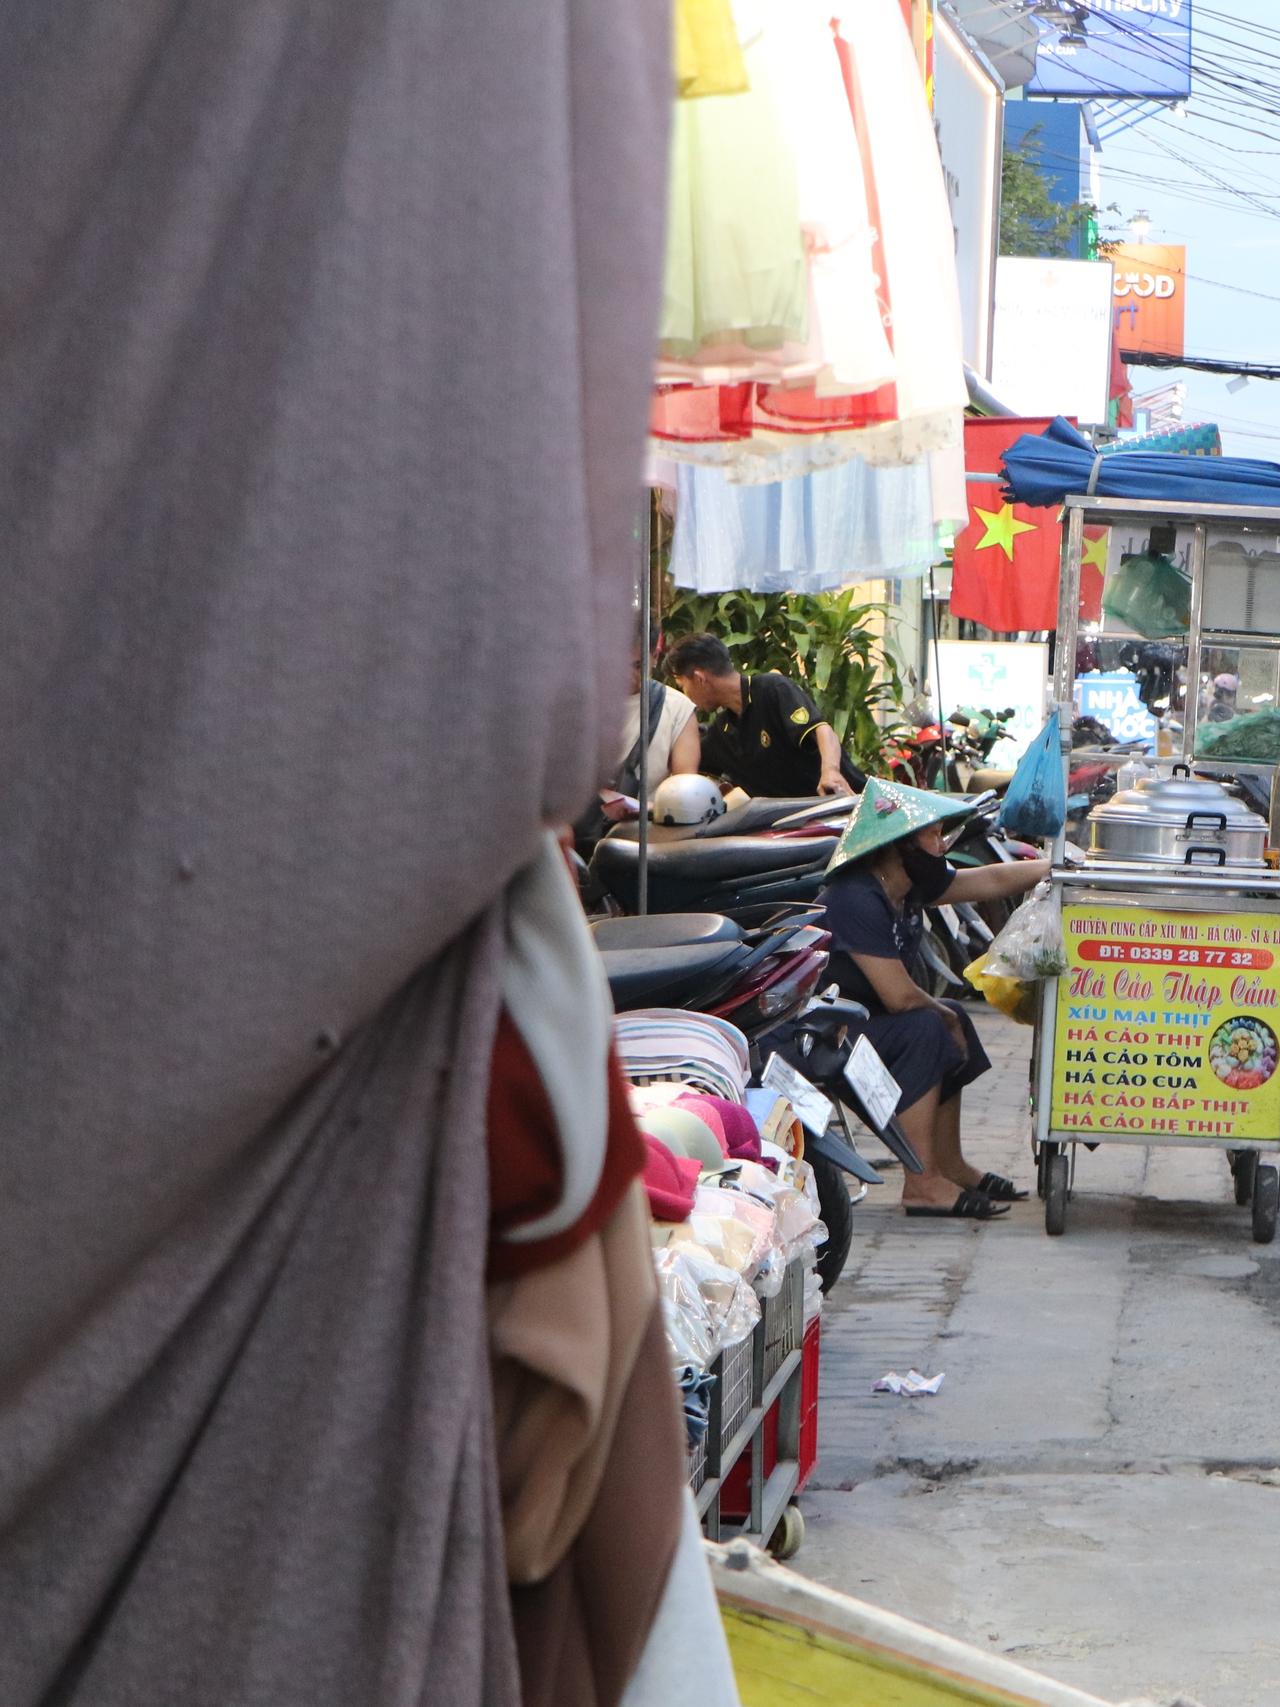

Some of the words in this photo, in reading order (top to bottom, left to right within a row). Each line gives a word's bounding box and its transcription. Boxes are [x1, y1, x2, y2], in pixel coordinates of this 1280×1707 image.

[1113, 272, 1175, 299] OOD
[1070, 918, 1107, 935] CHUYÊN
[1111, 921, 1135, 936] CUNG
[1139, 919, 1157, 938] CẤP
[1160, 921, 1177, 939] XÍU
[1180, 925, 1198, 942] MẠI
[1207, 924, 1220, 941] HÁ
[1223, 924, 1242, 942] CẢO
[1263, 930, 1270, 944] &
[1100, 945, 1124, 958] ĐT:
[1130, 947, 1173, 960] 0339
[1178, 949, 1199, 962] 28
[1204, 951, 1226, 964] 77
[1231, 953, 1252, 965] 32
[1070, 967, 1106, 998] Há
[1113, 968, 1154, 1000] Cảo
[1163, 971, 1223, 1010] Thập
[1230, 975, 1278, 1007] Cẩm
[1068, 1004, 1107, 1020] XÍU
[1113, 1009, 1156, 1025] MẠI
[1162, 1012, 1211, 1028] THỊT
[1067, 1026, 1098, 1041] HÁ
[1104, 1027, 1149, 1044] CẢO
[1155, 1033, 1204, 1049] THỊT
[1066, 1047, 1097, 1062] HÁ
[1103, 1048, 1148, 1065] CẢO
[1154, 1051, 1202, 1068] TÔM
[1065, 1068, 1096, 1083] HÁ
[1102, 1069, 1147, 1086] CẢO
[1152, 1075, 1197, 1088] CUA
[1064, 1090, 1094, 1105] HÁ
[1100, 1091, 1145, 1107] CẢO
[1200, 1099, 1249, 1116] THỊT
[1063, 1111, 1093, 1126] HÁ
[1099, 1112, 1144, 1128] CẢO
[1151, 1118, 1179, 1133] HẸ
[1186, 1120, 1234, 1137] THỊT
